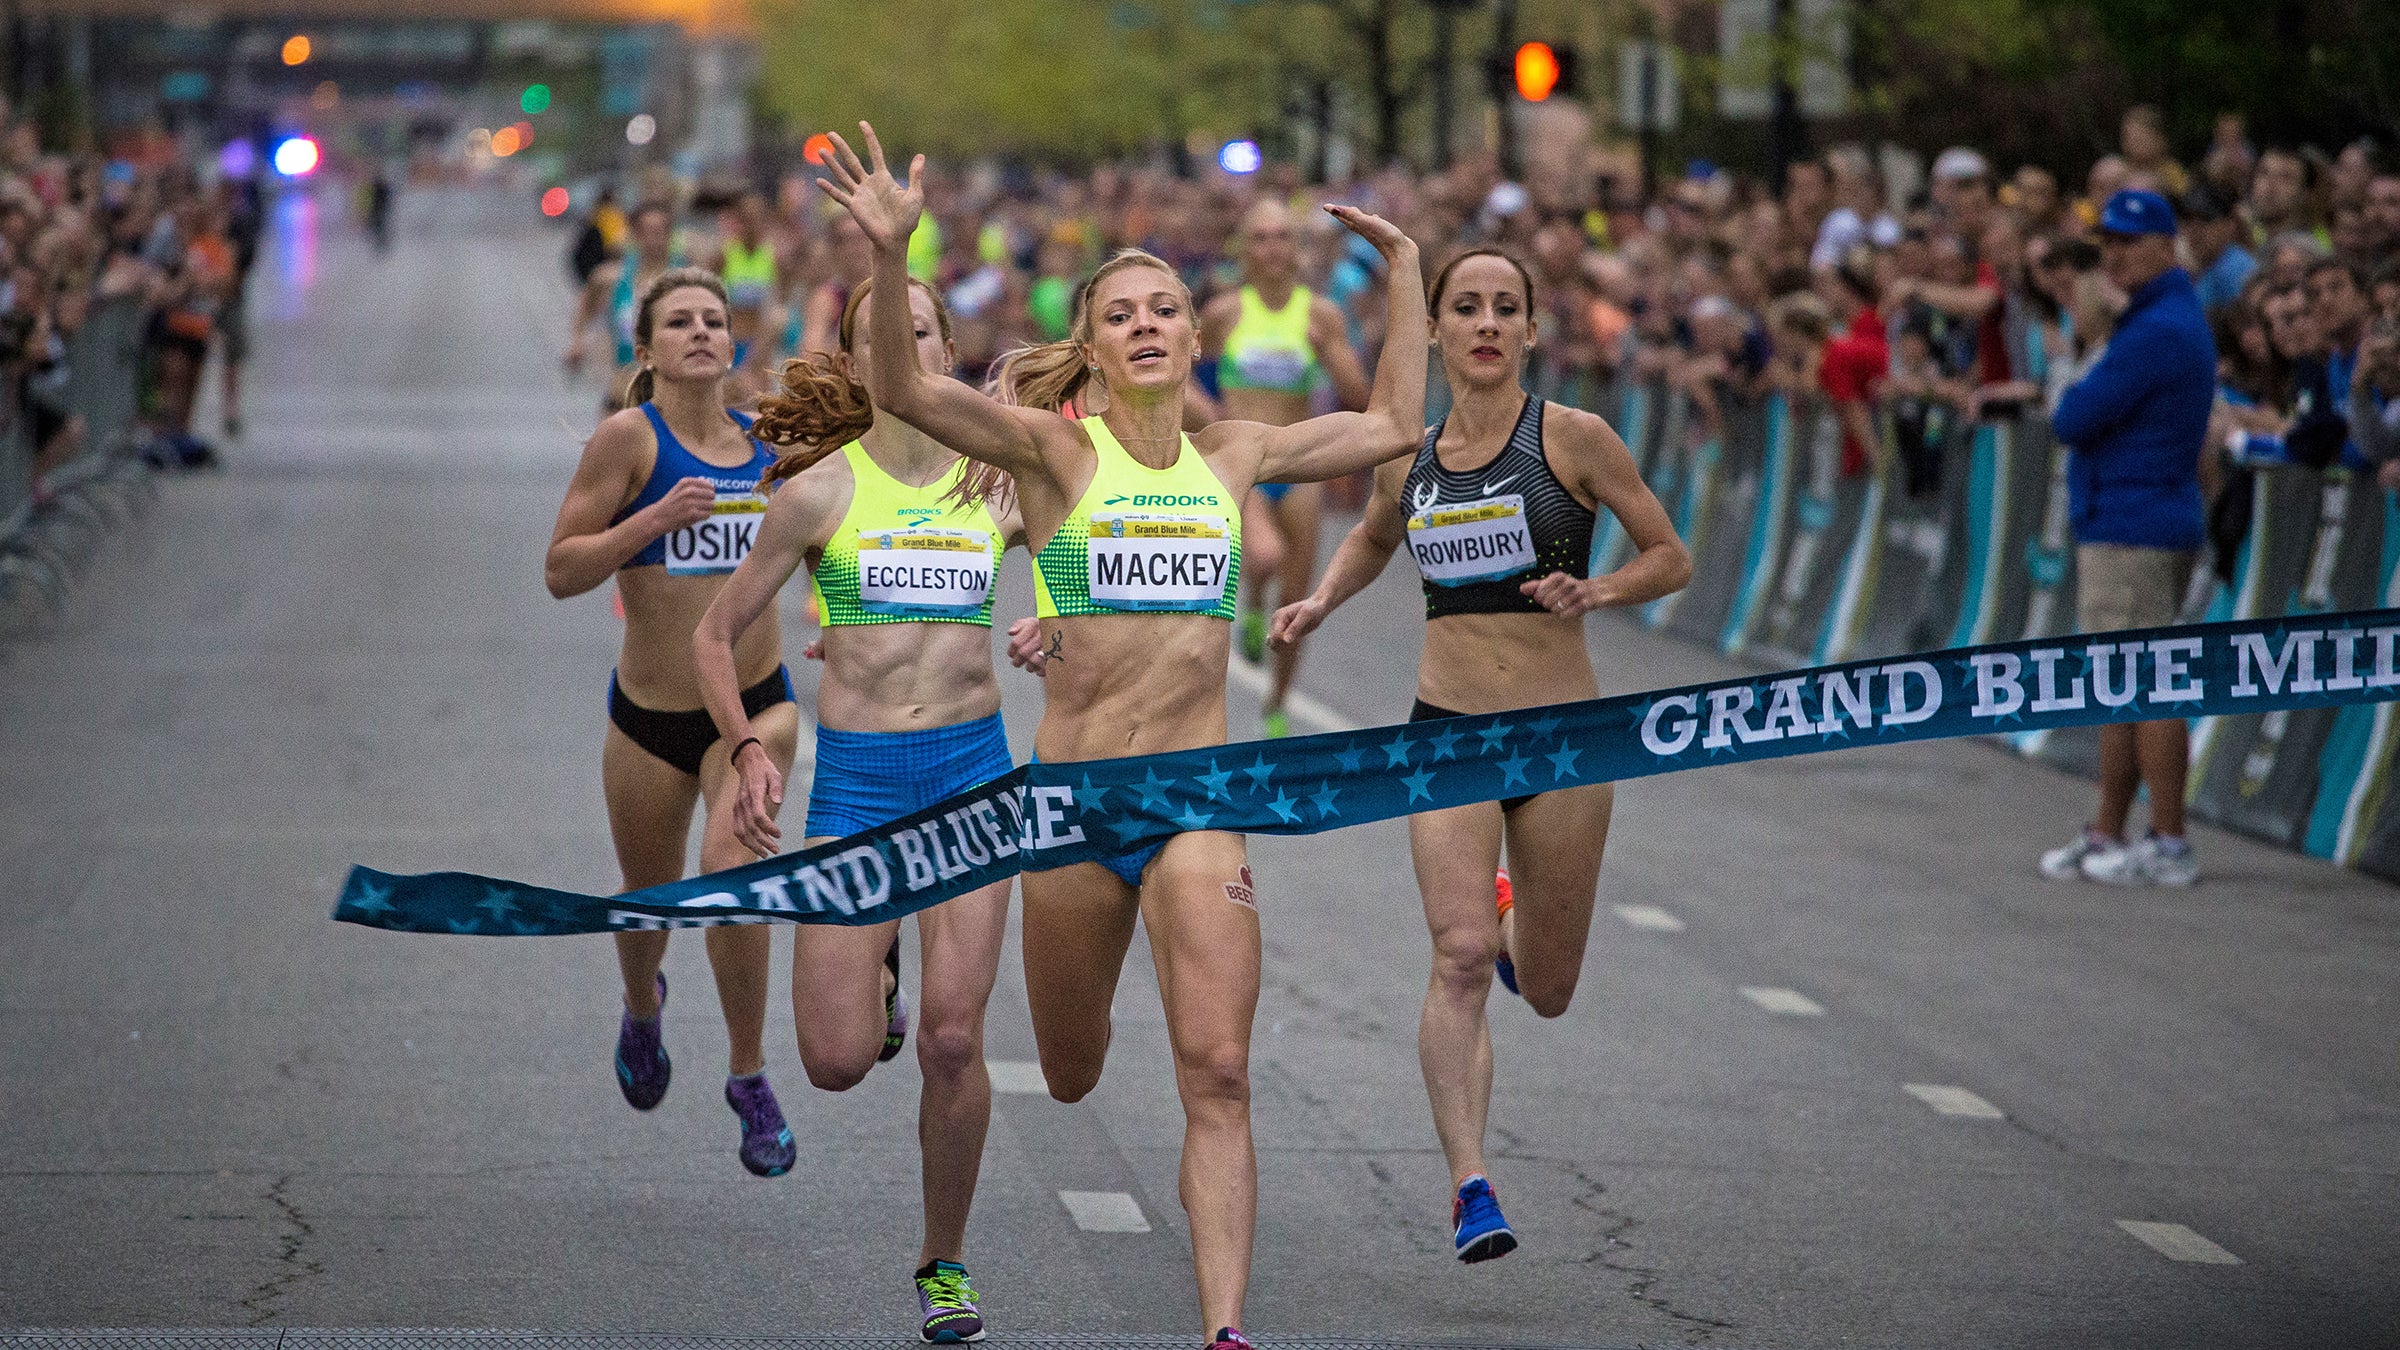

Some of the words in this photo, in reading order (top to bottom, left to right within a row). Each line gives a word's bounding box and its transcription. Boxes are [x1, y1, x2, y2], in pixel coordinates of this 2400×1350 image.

[1132, 494, 1218, 507] BROOKS
[897, 508, 942, 516] BROOKS
[1134, 524, 1159, 535] Grand
[1161, 525, 1178, 535] Blue
[1180, 525, 1196, 536] Mile
[902, 538, 925, 548] Grand
[927, 539, 944, 548] Blue
[945, 540, 961, 549] Mile
[1415, 529, 1524, 566] ROWBURY
[867, 566, 987, 591] ECCLESTON
[1097, 553, 1227, 586] MACKEY
[1641, 661, 1943, 756] GRAND
[1970, 637, 2204, 718] BLUE
[890, 798, 1019, 892] BLUE
[925, 1312, 979, 1329] BROOKS
